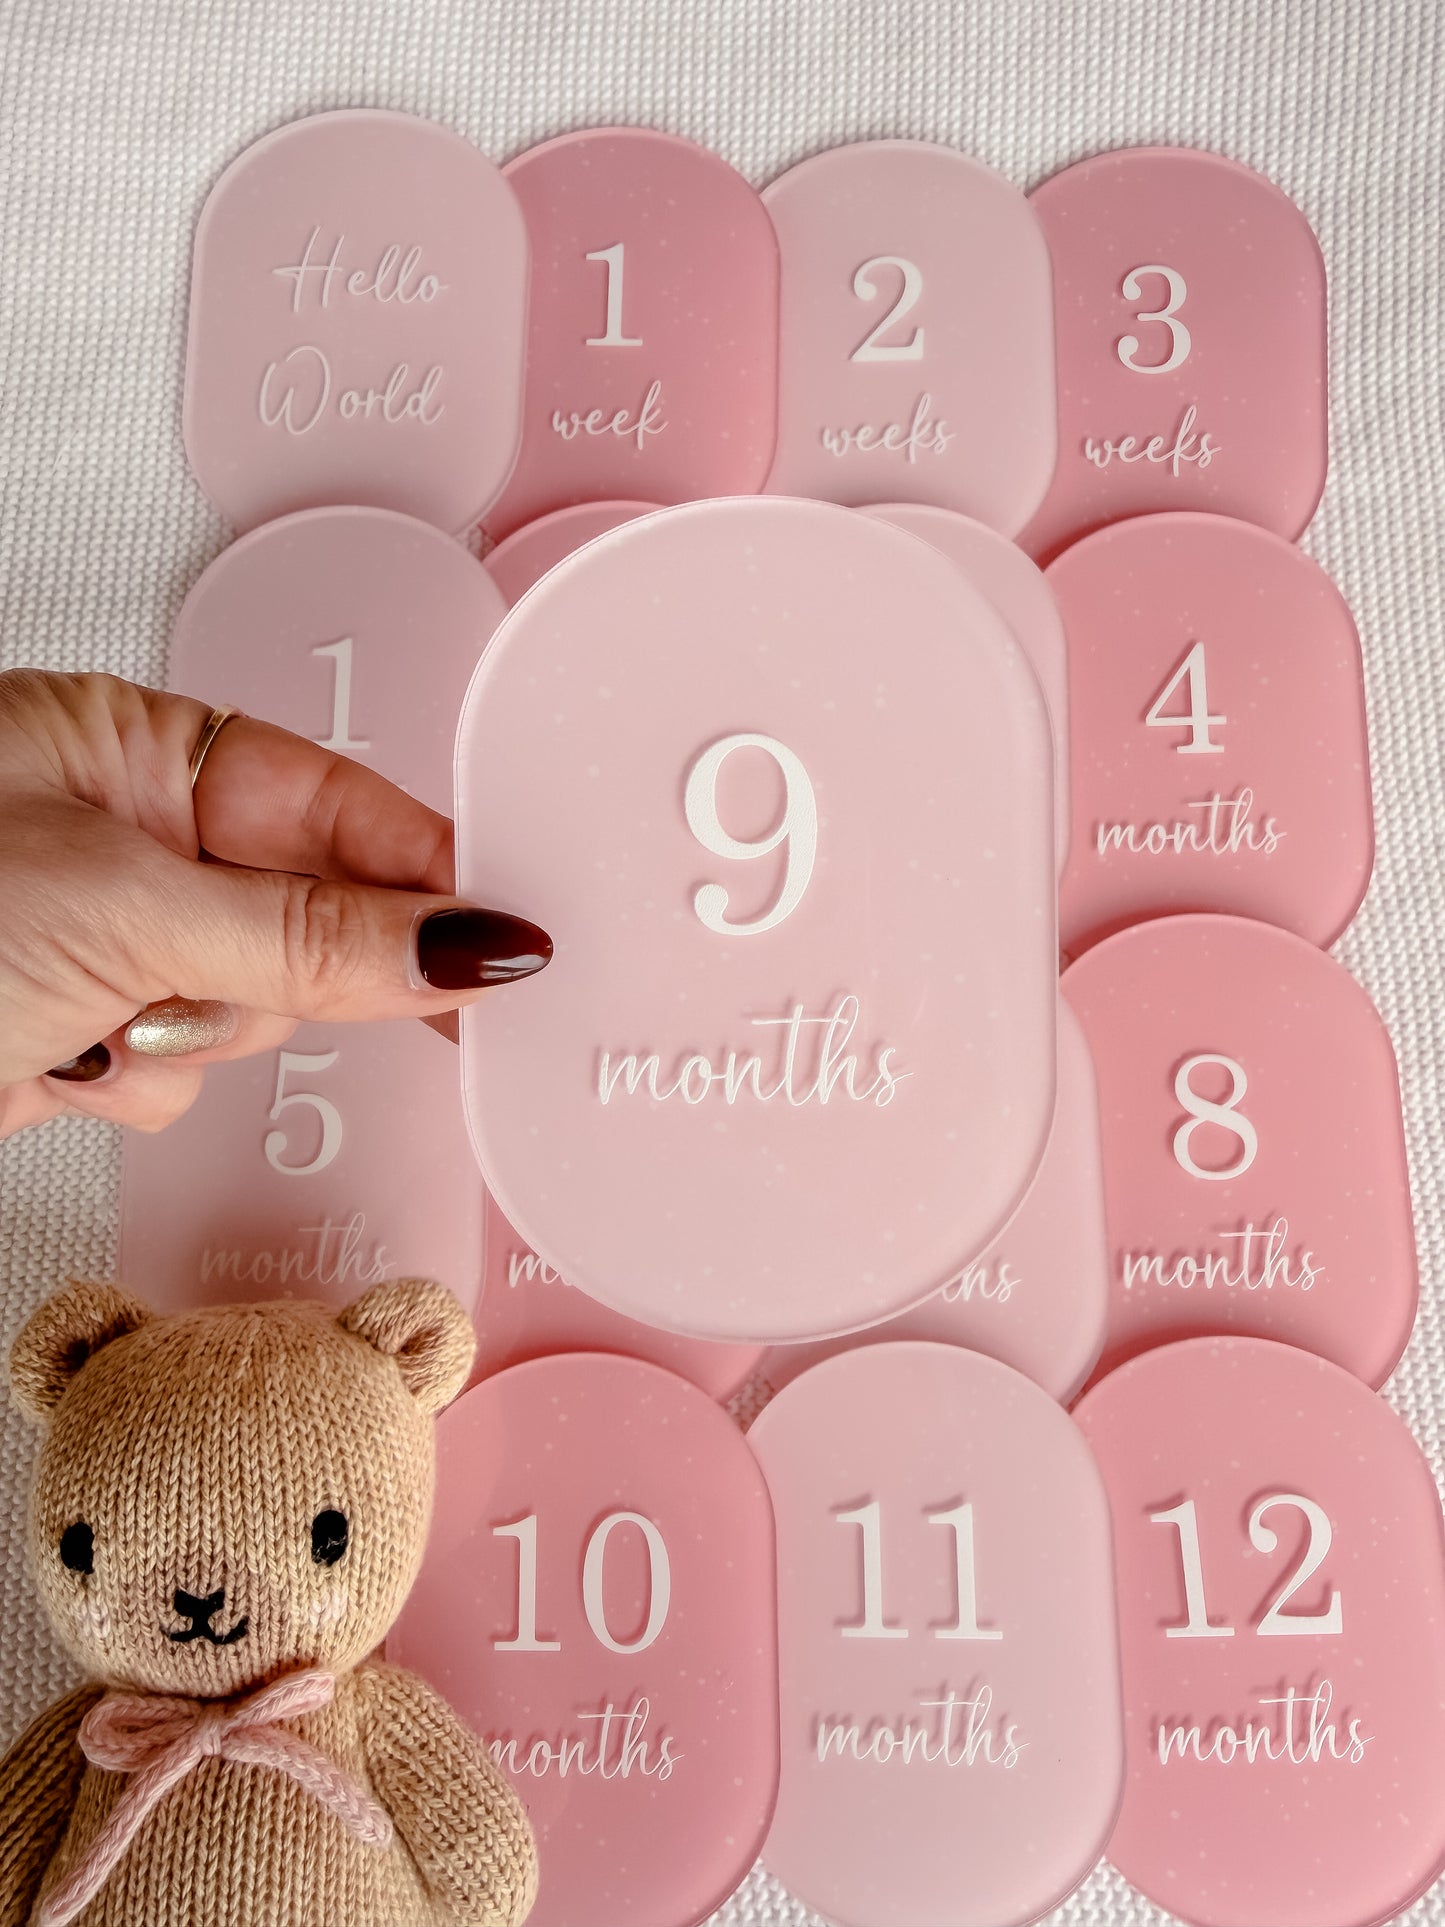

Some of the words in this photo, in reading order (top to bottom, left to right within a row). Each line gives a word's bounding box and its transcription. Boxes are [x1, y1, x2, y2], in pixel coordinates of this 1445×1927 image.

[272, 225, 448, 312] Hello
[585, 242, 643, 346] 1
[850, 255, 924, 362] 2
[1116, 264, 1192, 374] 3
[259, 345, 445, 435] World
[552, 381, 668, 450] week
[822, 392, 955, 464] weeks
[1085, 404, 1222, 477] weeks
[311, 637, 370, 749] 1
[1145, 641, 1227, 754] 4
[685, 733, 818, 935] 9
[1097, 787, 1287, 855] months
[598, 995, 914, 1107] months
[264, 1051, 343, 1175] 5
[1173, 1053, 1258, 1180] 8
[201, 1212, 397, 1284] months
[1123, 1217, 1326, 1290] months
[493, 1512, 671, 1654] 10
[836, 1501, 1003, 1639] 11
[1150, 1494, 1343, 1638] 12
[817, 1685, 1030, 1768] months
[1158, 1679, 1375, 1764] months
